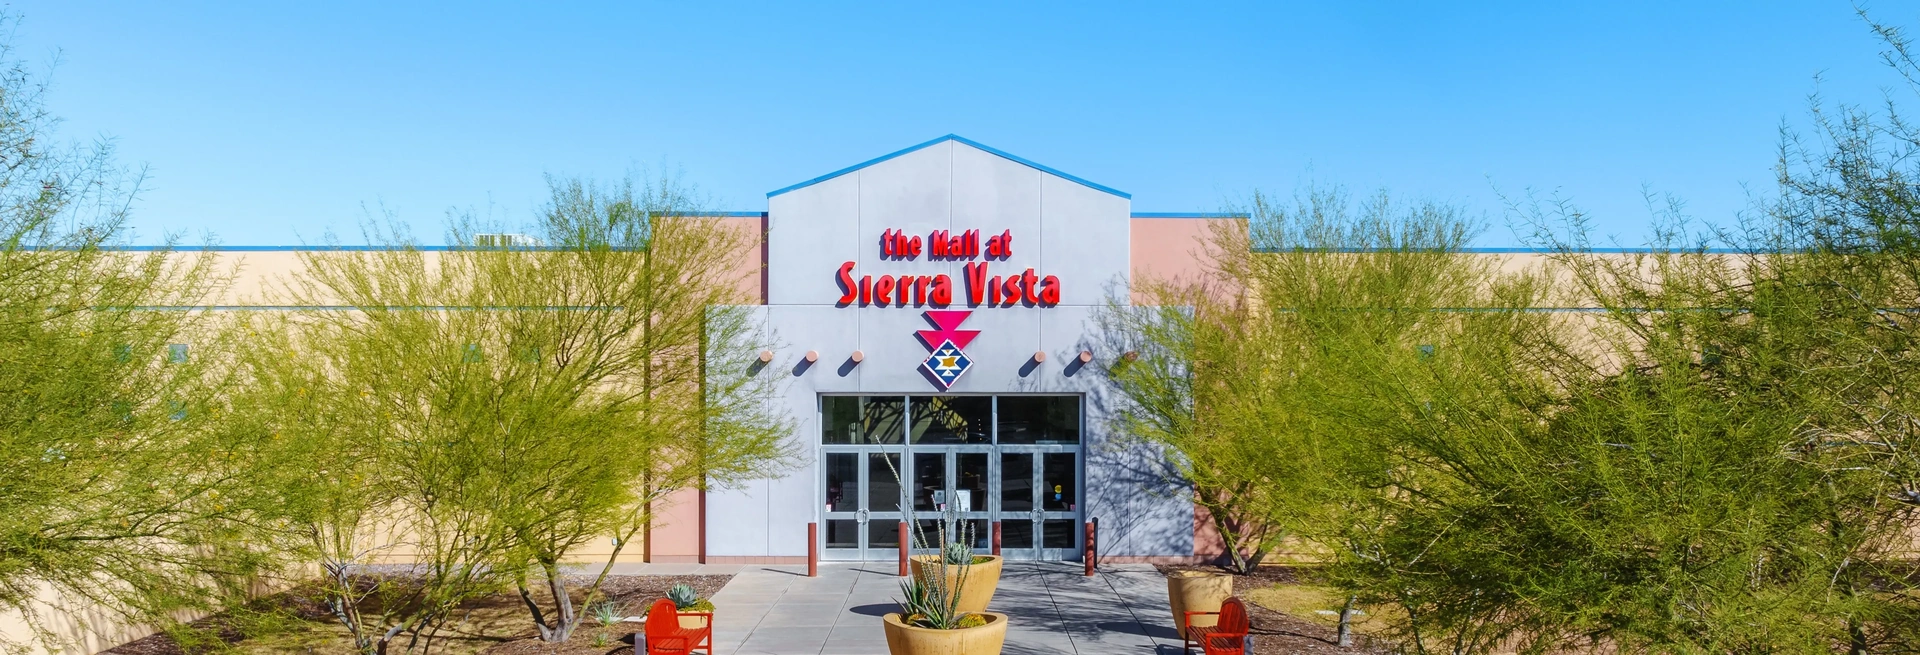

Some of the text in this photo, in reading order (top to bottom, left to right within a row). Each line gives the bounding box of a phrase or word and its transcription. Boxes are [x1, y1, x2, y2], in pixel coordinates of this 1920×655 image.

[883, 228, 1012, 256] the Mall at
[839, 261, 1061, 305] Sierra Vista
